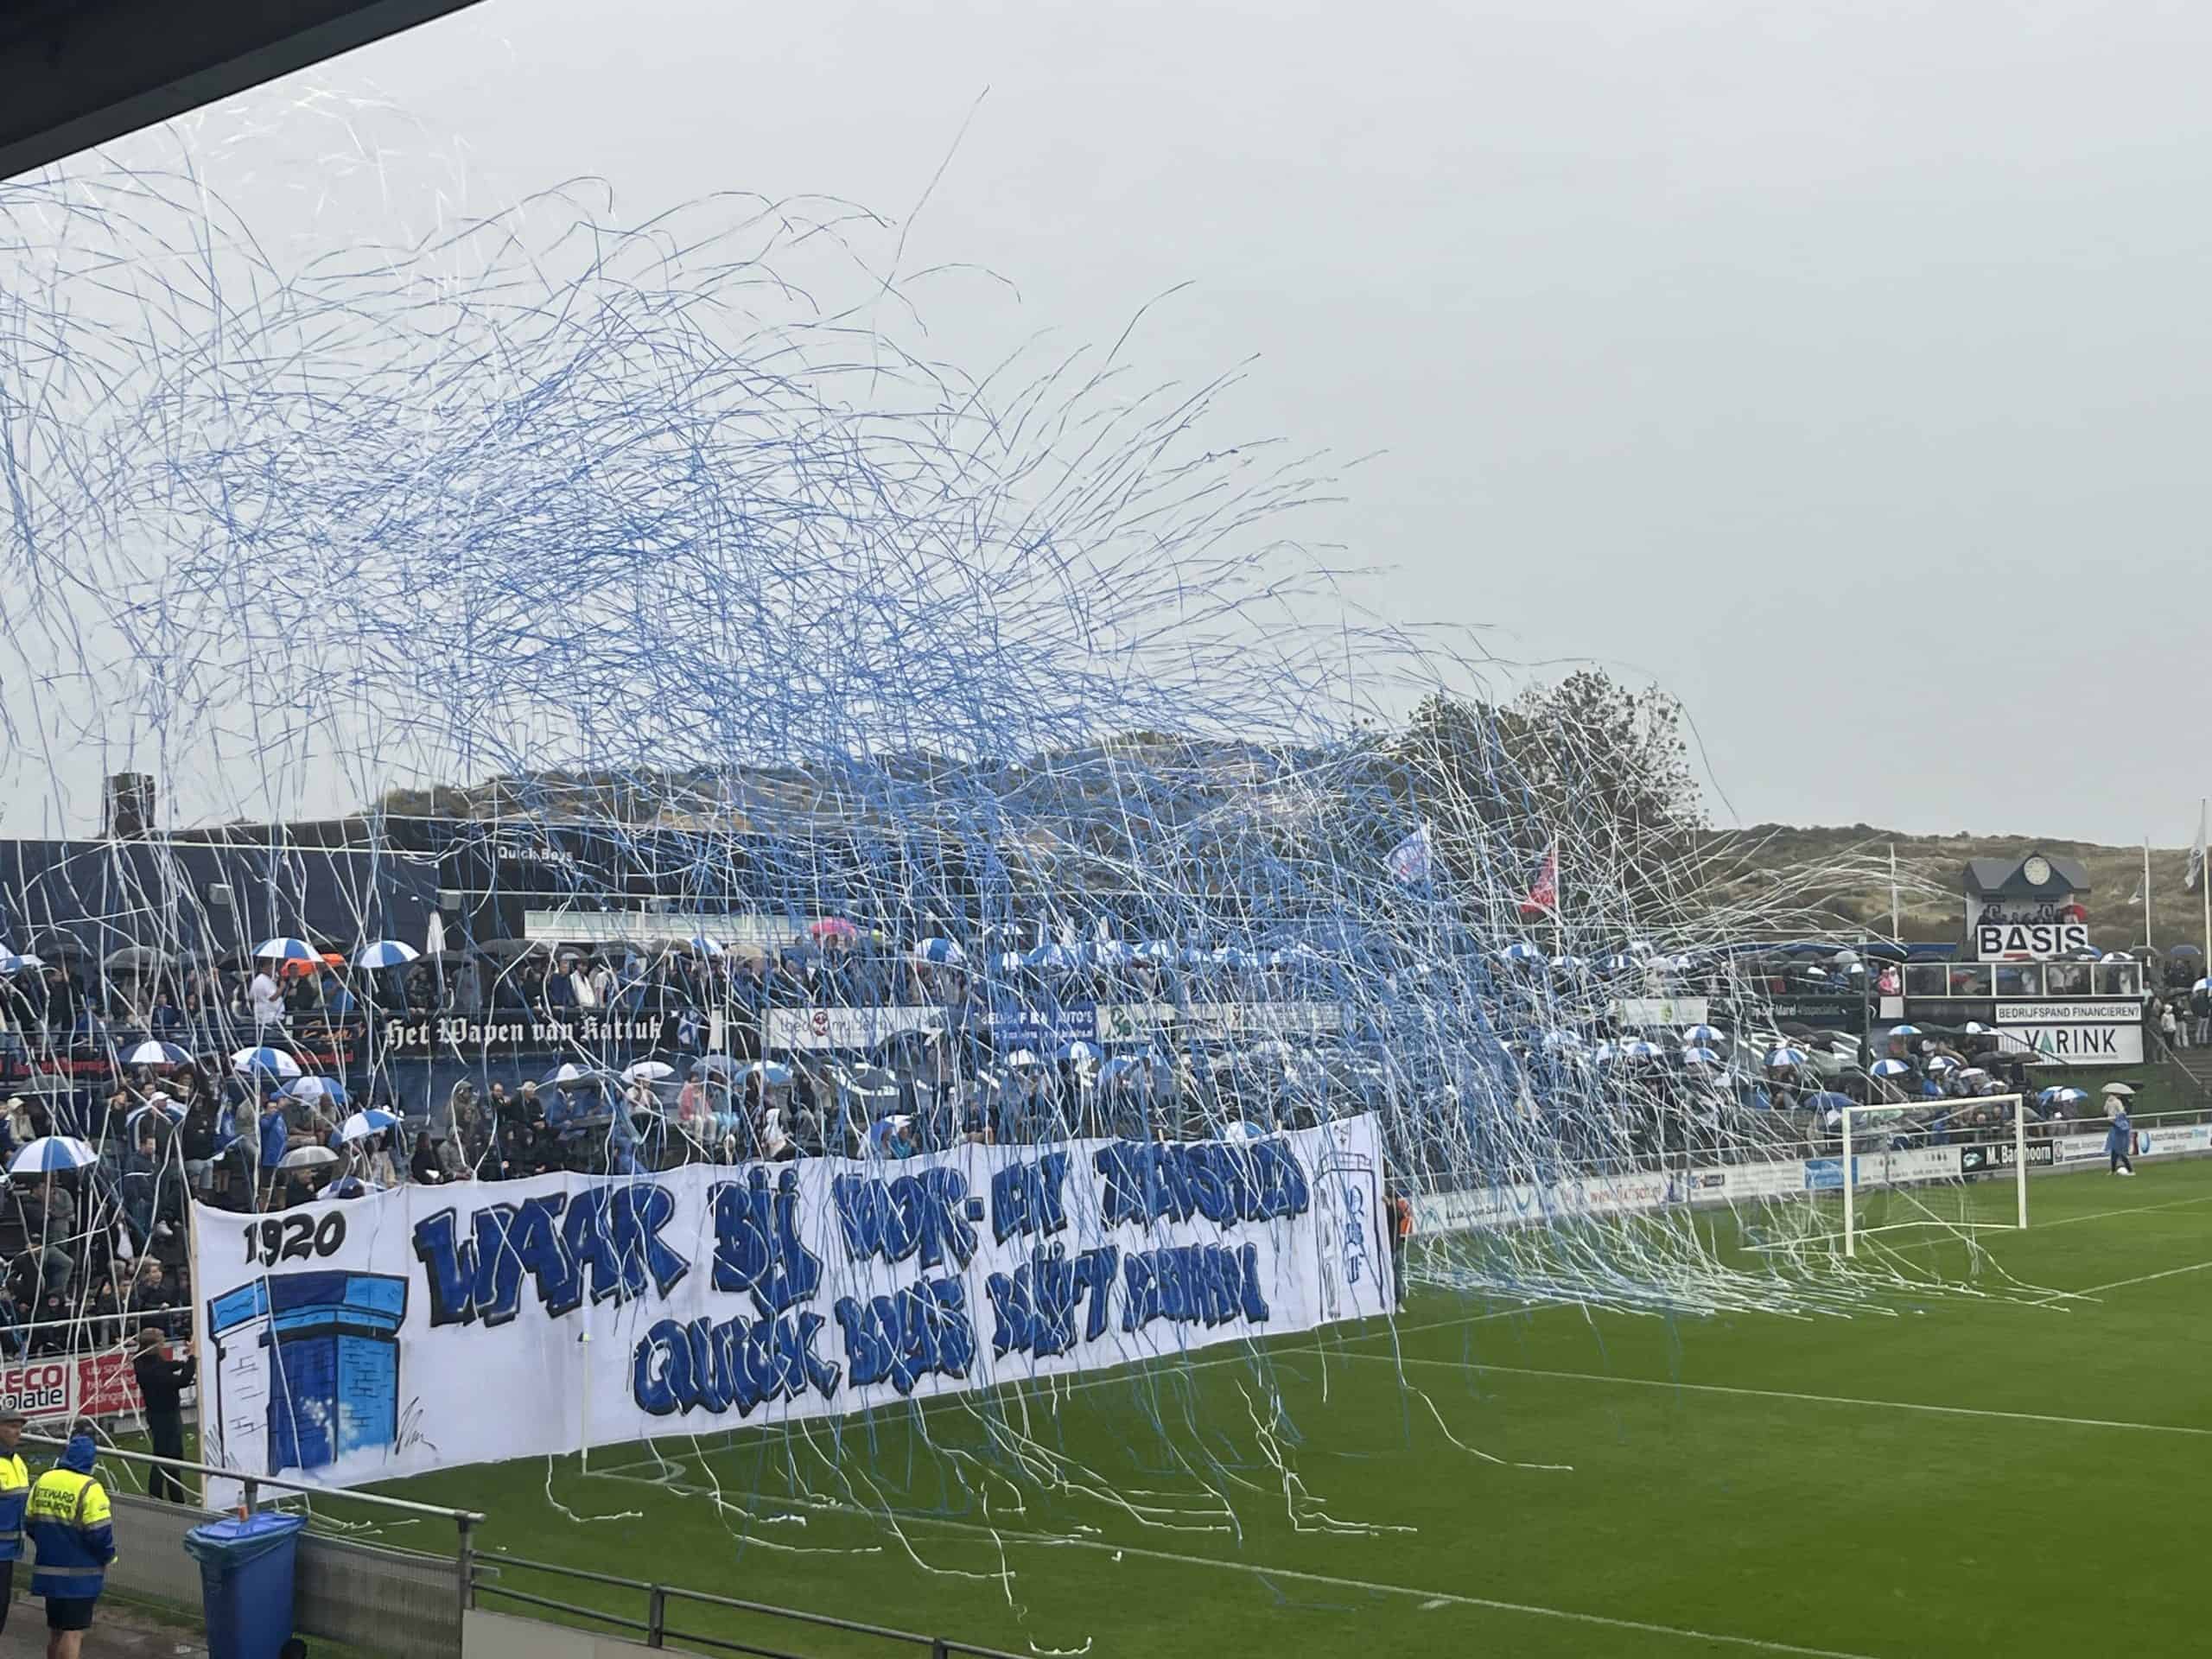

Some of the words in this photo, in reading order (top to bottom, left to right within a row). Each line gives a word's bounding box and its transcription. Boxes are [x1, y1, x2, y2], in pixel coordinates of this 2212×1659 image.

[498, 846, 538, 860] Quick
[1980, 926, 2086, 953] BASIS
[1999, 1007, 2070, 1019] BEDRIJFSPAND
[2073, 1006, 2139, 1017] FINANCIEREN?
[386, 1020, 430, 1051] Het
[435, 1017, 524, 1046] Wapen
[531, 1021, 575, 1040] van
[580, 1015, 664, 1040] Kattuk
[2024, 1029, 2117, 1053] VARINK
[2001, 1142, 2051, 1164] Barhoorn
[243, 1210, 346, 1267] 1920
[412, 1182, 691, 1328] WAAR
[707, 1166, 823, 1318] BIJ
[632, 1310, 842, 1417] QUICK
[835, 1274, 976, 1395] BOYS
